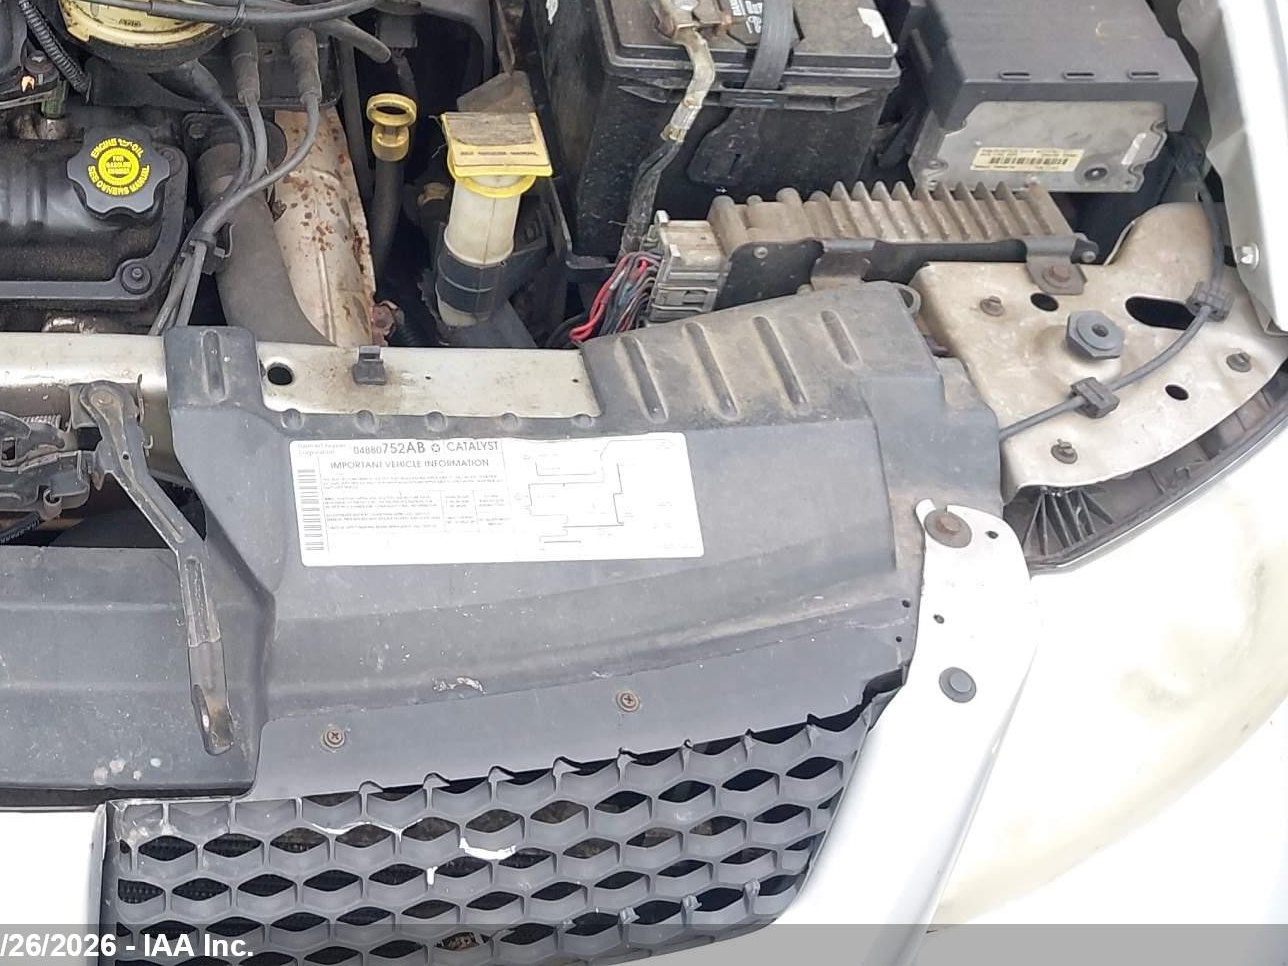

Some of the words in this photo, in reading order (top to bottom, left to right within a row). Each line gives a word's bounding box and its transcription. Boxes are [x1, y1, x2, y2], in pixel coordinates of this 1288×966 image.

[90, 138, 117, 158] ENGINE
[132, 144, 144, 158] OIL
[88, 165, 99, 182] SEE
[129, 164, 150, 192] MANUAL
[446, 441, 499, 452] CATALYST
[330, 460, 383, 469] IMPORTANT
[385, 460, 421, 468] VEHICLE
[424, 458, 489, 468] INFORMATION
